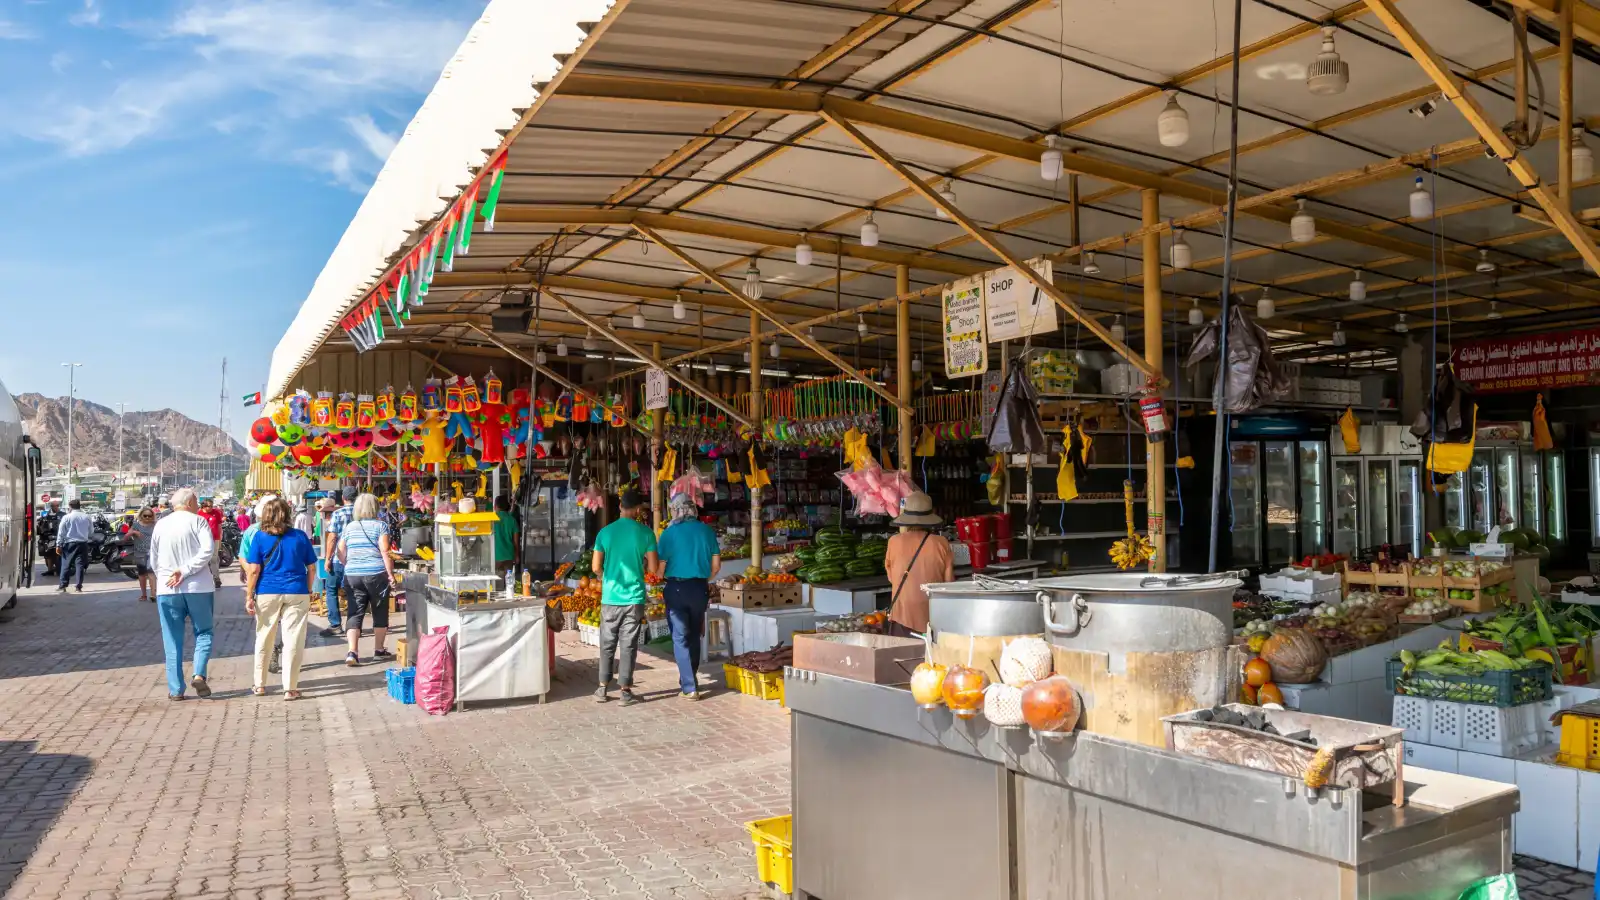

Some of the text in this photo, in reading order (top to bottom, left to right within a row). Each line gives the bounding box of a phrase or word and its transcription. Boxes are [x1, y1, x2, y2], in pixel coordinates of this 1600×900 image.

[991, 278, 1013, 294] SHOP
[1460, 366, 1484, 381] IBRAHIM
[1485, 363, 1516, 379] ABDULLAH
[1538, 359, 1557, 374] FRUIT
[1558, 357, 1571, 372] AND
[1572, 356, 1588, 371] VEG.
[653, 381, 662, 396] 10
